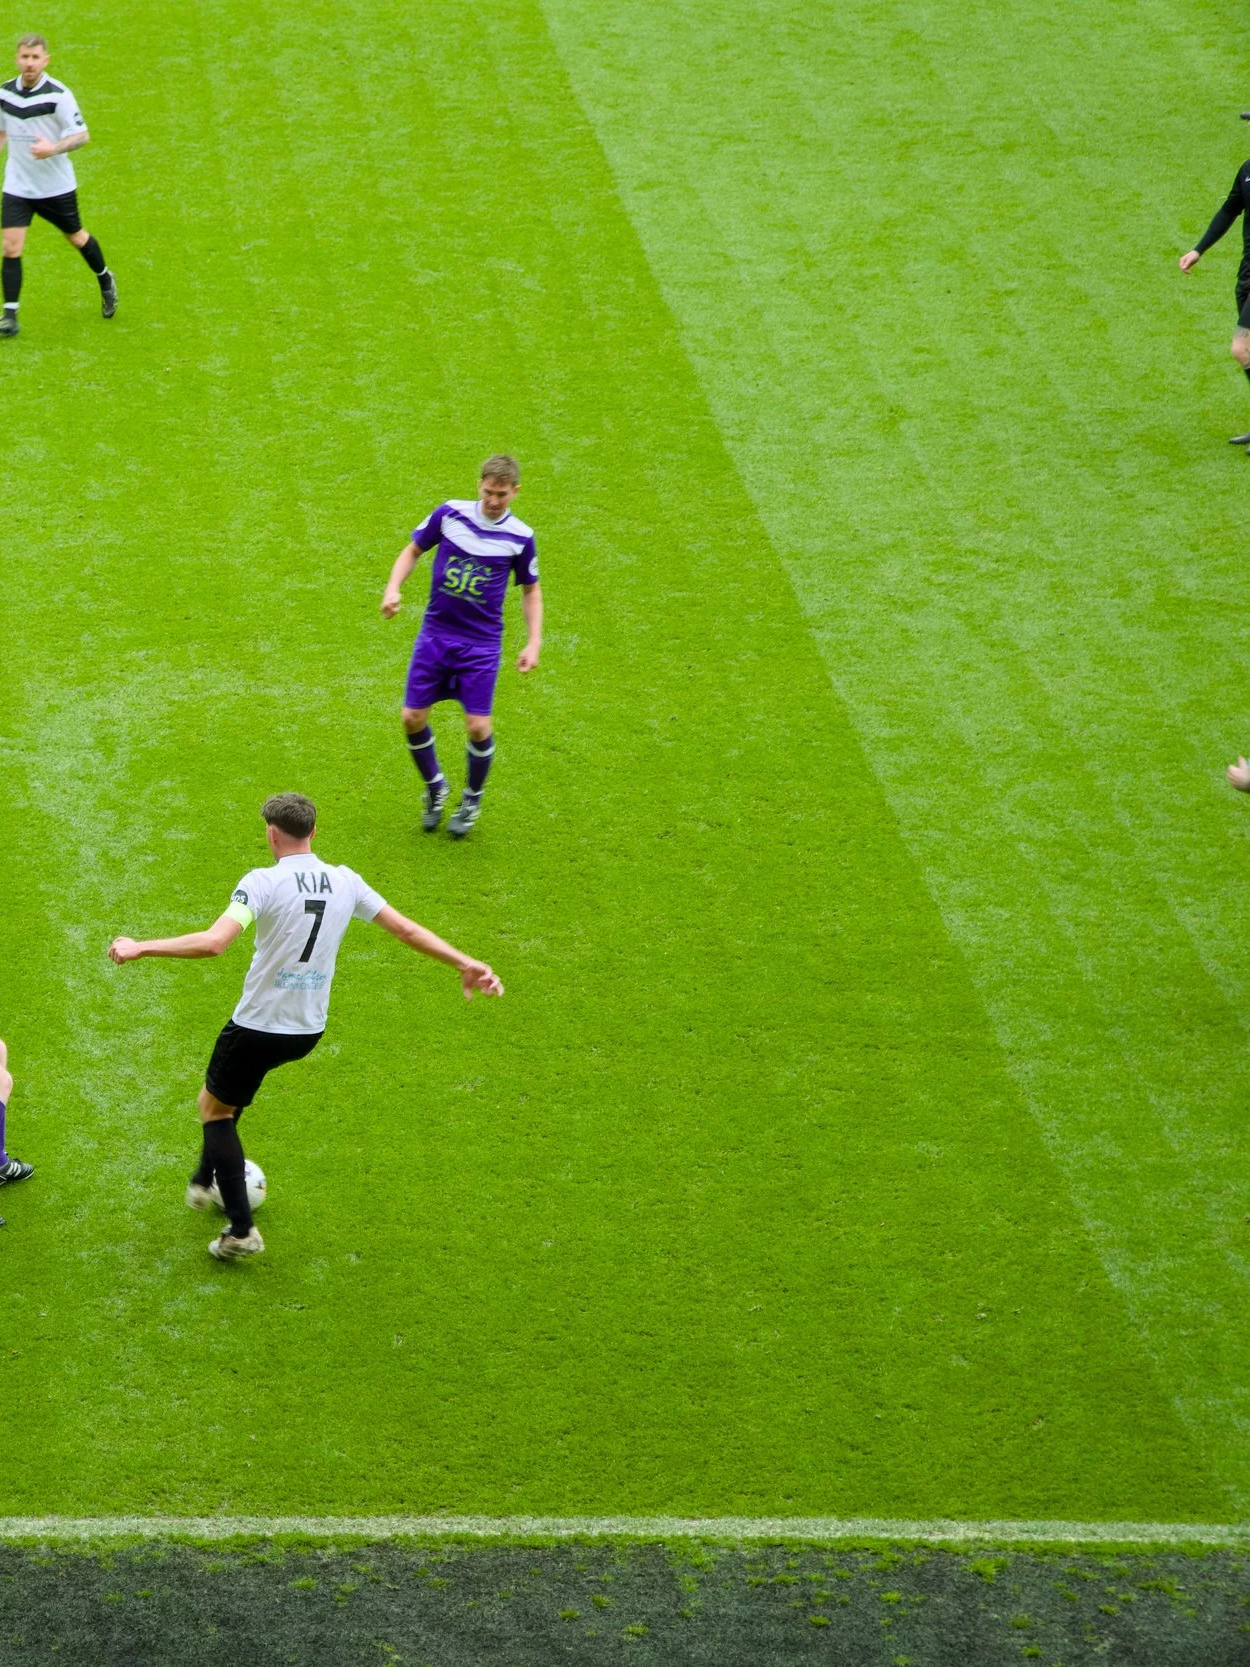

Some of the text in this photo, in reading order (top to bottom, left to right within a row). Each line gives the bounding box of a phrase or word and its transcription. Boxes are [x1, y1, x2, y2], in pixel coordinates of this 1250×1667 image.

[443, 563, 488, 596] sjc
[294, 871, 333, 894] KIA
[298, 899, 327, 963] 7
